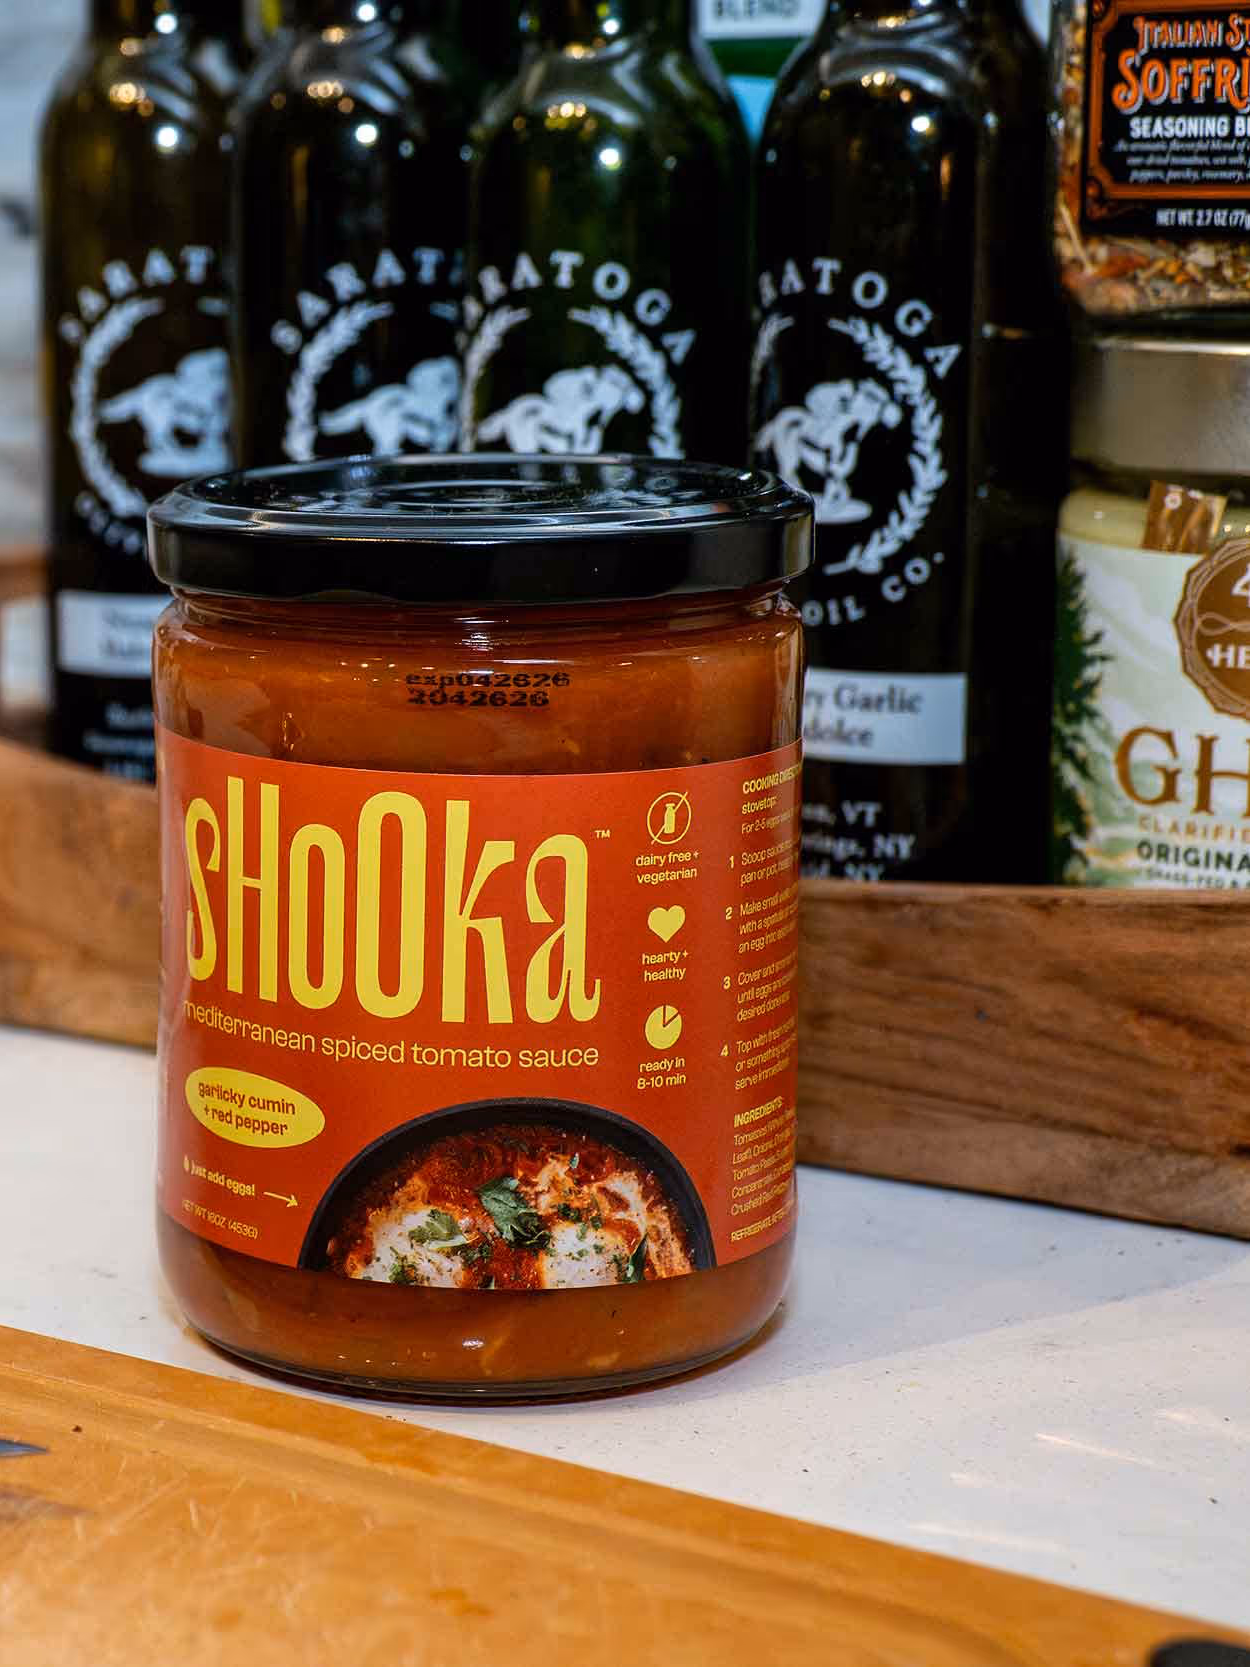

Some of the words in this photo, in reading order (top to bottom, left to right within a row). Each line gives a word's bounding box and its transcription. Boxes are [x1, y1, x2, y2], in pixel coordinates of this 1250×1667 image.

[1130, 115, 1230, 139] SEASONING
[1156, 208, 1176, 226] NET
[1214, 208, 1228, 226] OZ
[834, 681, 922, 713] Garlic
[743, 772, 779, 795] COOKING
[841, 801, 882, 827] VT
[873, 834, 916, 860] NY
[635, 855, 667, 868] dairy
[668, 851, 691, 864] free
[729, 855, 735, 869] 1
[636, 867, 698, 885] vegetarian
[740, 870, 757, 887] pan
[725, 906, 733, 921] 2
[740, 900, 762, 917] Make
[739, 919, 758, 936] with
[738, 941, 750, 954] an
[750, 936, 766, 952] egg
[642, 952, 682, 967] hearty
[644, 967, 687, 983] healthy
[722, 975, 731, 990] 3
[737, 968, 762, 986] Cover
[737, 986, 755, 1004] until
[736, 1001, 766, 1023] desired
[183, 1000, 316, 1054] mediterranean
[321, 1034, 406, 1063] spiced
[411, 1044, 512, 1068] tomato
[518, 1043, 600, 1068] sauce
[720, 1044, 730, 1057] 4
[736, 1040, 752, 1055] Top
[639, 1059, 675, 1074] ready
[675, 1057, 686, 1068] in
[735, 1060, 746, 1073] or
[637, 1075, 664, 1090] 8-10
[665, 1072, 687, 1087] min
[198, 1082, 246, 1108] garlicky
[248, 1094, 296, 1115] cumin
[235, 1115, 288, 1136] pepper
[207, 1171, 225, 1186] add
[226, 1178, 255, 1197] eggs!
